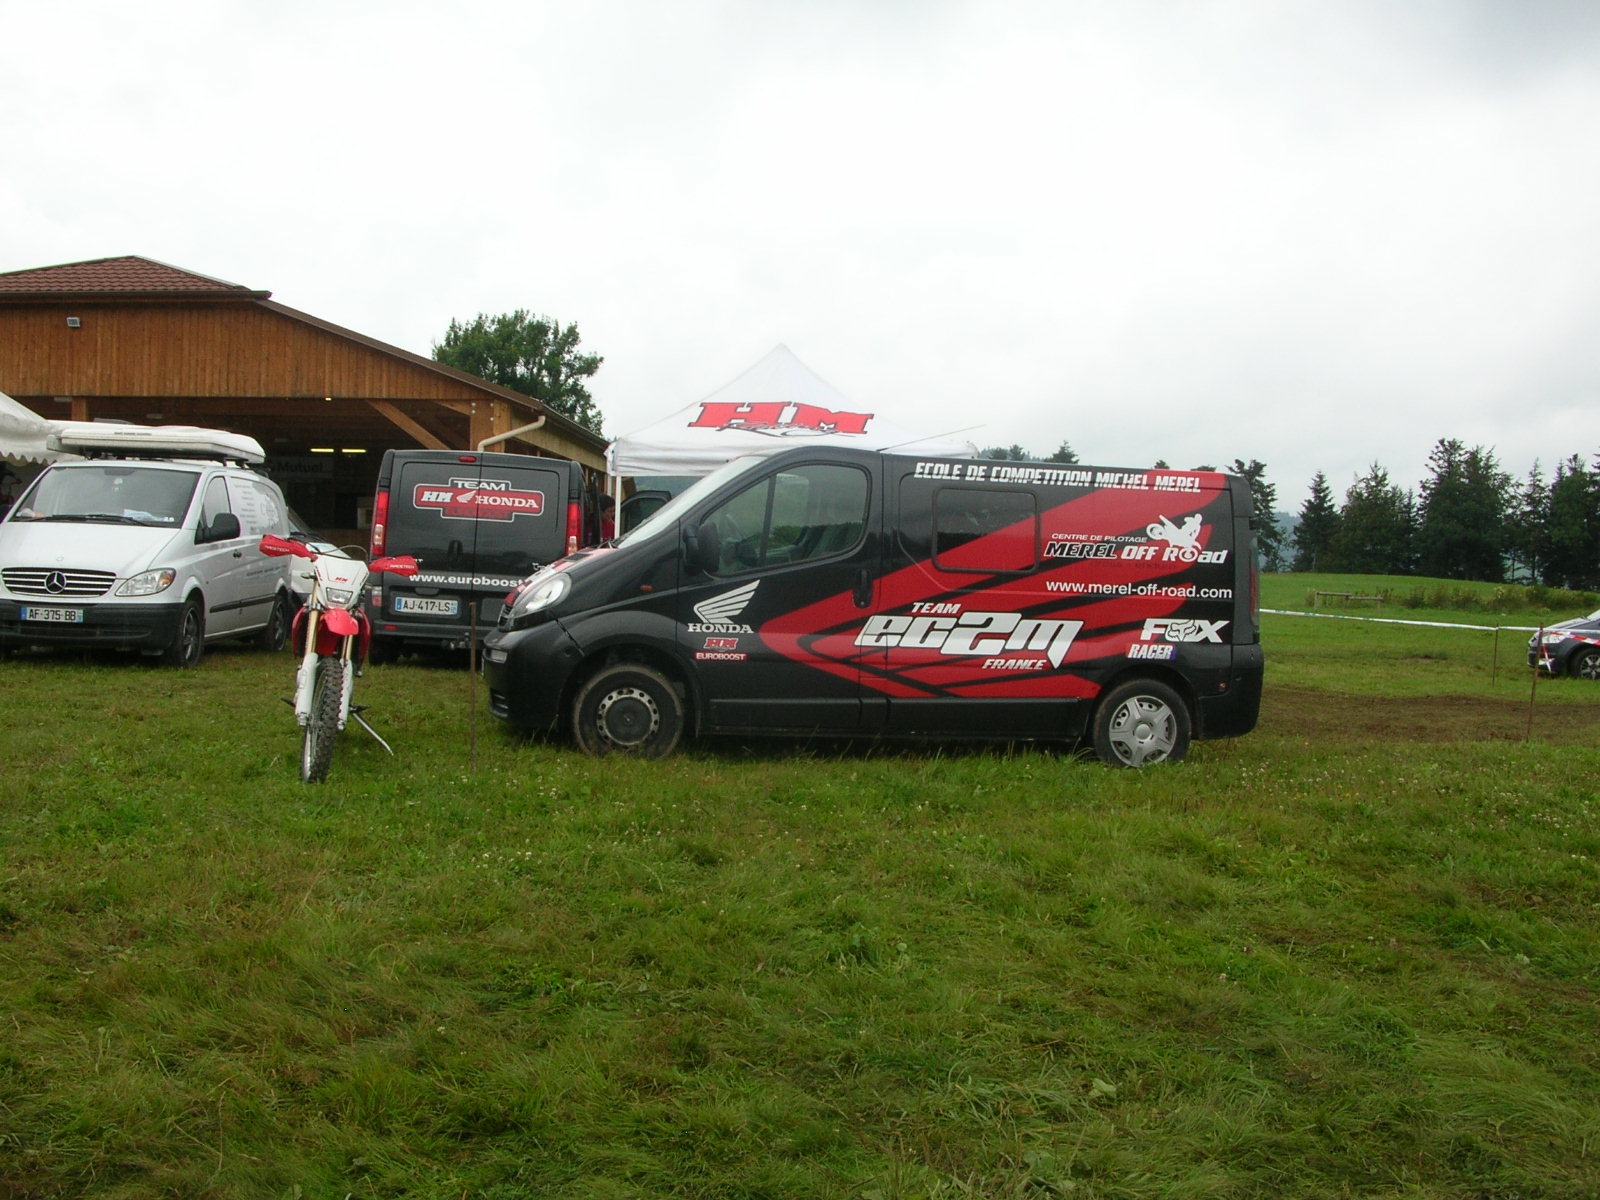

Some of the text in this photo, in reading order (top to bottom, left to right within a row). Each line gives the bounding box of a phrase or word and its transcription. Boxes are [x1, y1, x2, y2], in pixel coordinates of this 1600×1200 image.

[914, 462, 1201, 493] ECOLE DE COMPETITION MICHEL MEREL
[453, 480, 506, 491] TEAM
[421, 491, 540, 509] HM HONDA
[1051, 533, 1089, 541] CENTRE
[1043, 541, 1118, 560] MEREL
[1120, 545, 1160, 560] OFF
[1046, 581, 1233, 598] www.merel-off-road.com
[912, 602, 962, 614] TEAM
[687, 623, 754, 634] HONDA
[695, 652, 747, 661] EUROBOOST
[1127, 644, 1174, 660] RACER
[982, 658, 1047, 670] FRANCE
